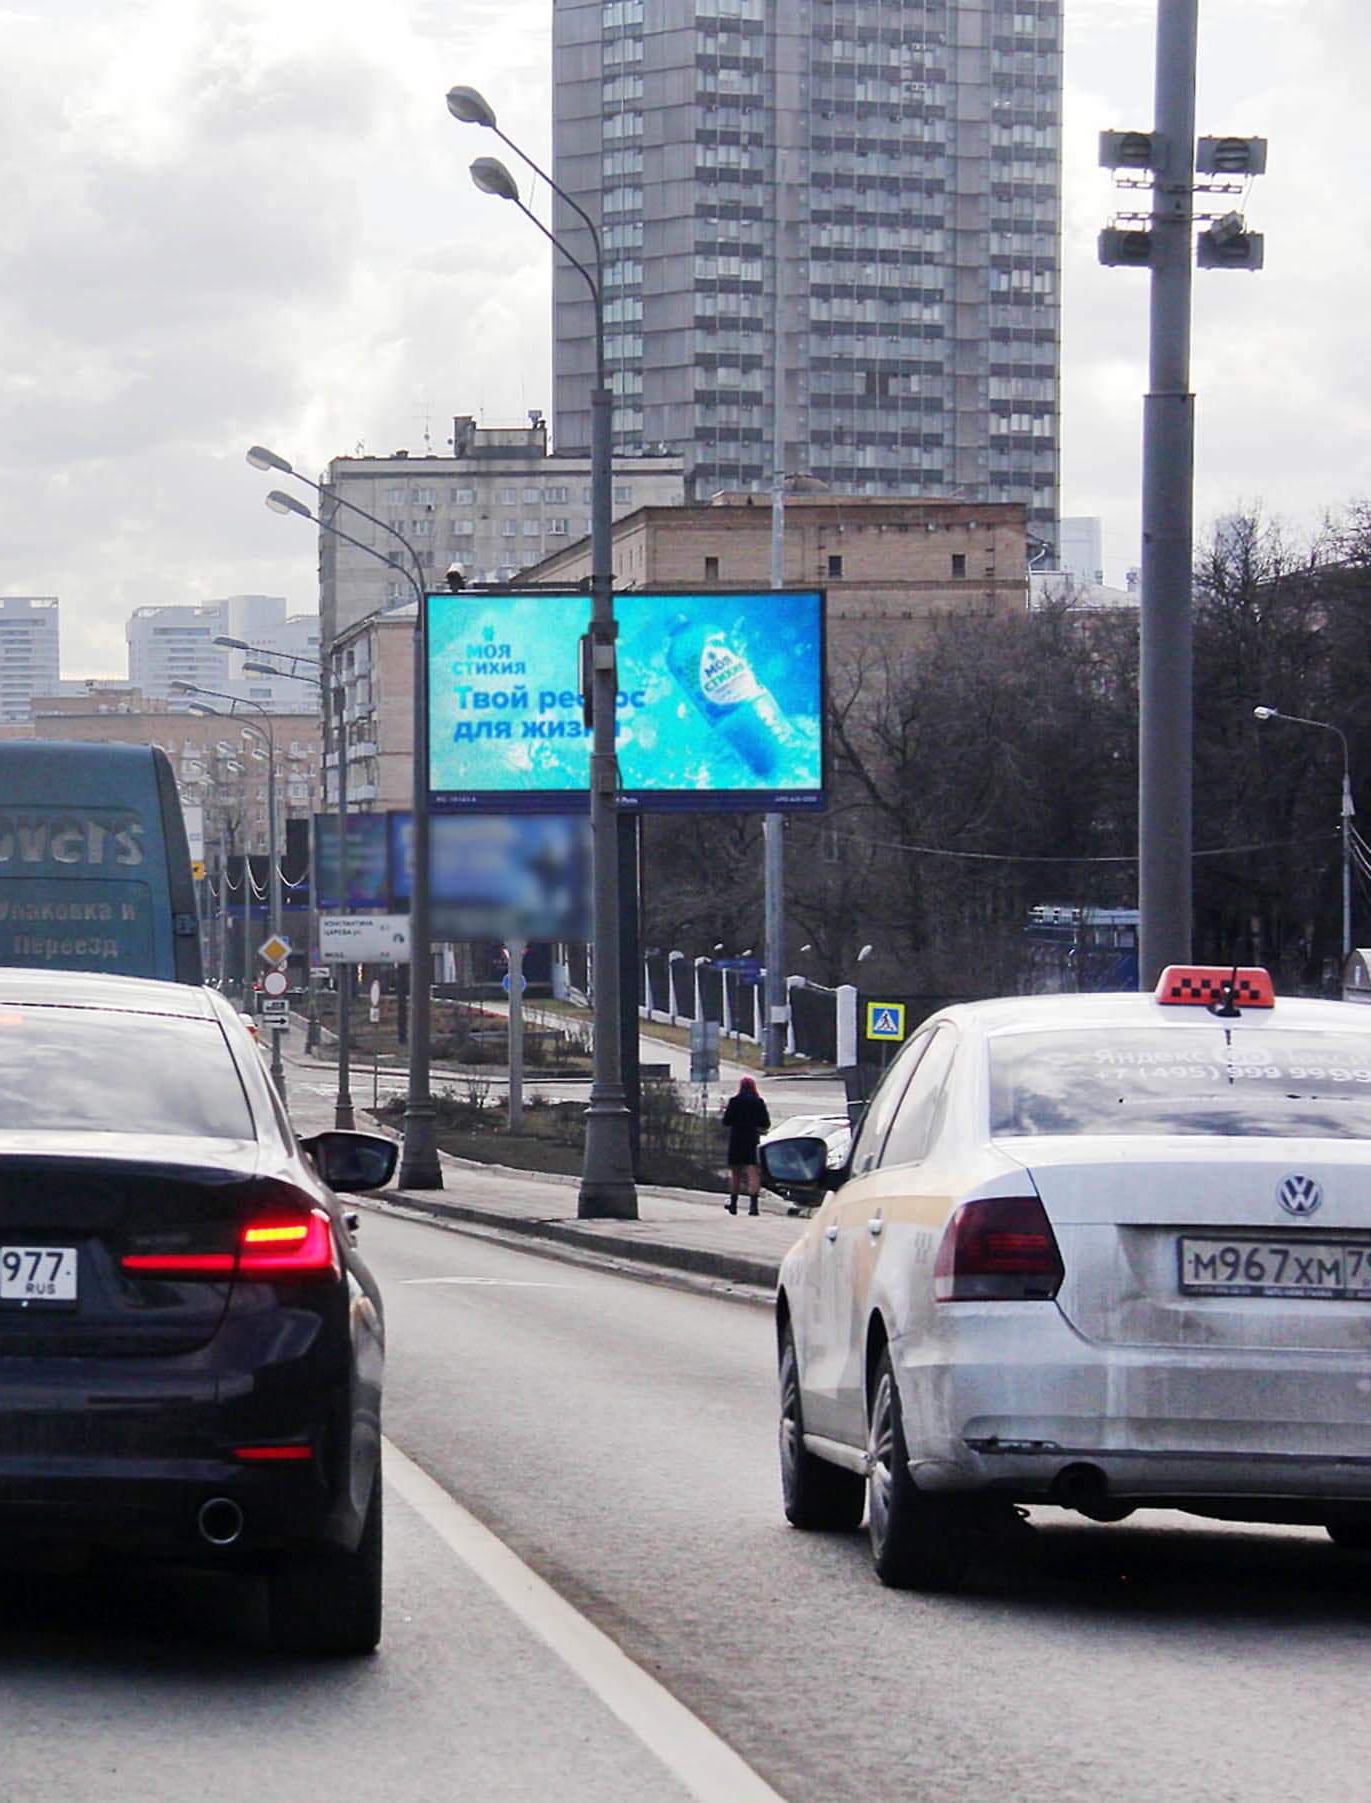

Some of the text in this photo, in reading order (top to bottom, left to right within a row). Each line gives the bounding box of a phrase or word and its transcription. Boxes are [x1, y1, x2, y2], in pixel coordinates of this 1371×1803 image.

[453, 685, 528, 710] Твой
[453, 720, 511, 742] для
[13, 935, 118, 960] Переезд
[1095, 1048, 1206, 1066] Яндекс
[1140, 1065, 1220, 1081] (495)
[1226, 1065, 1282, 1079] 999
[2, 1251, 65, 1283] 977
[1193, 1245, 1341, 1285] М967ХМ
[26, 1282, 57, 1295] RUS
